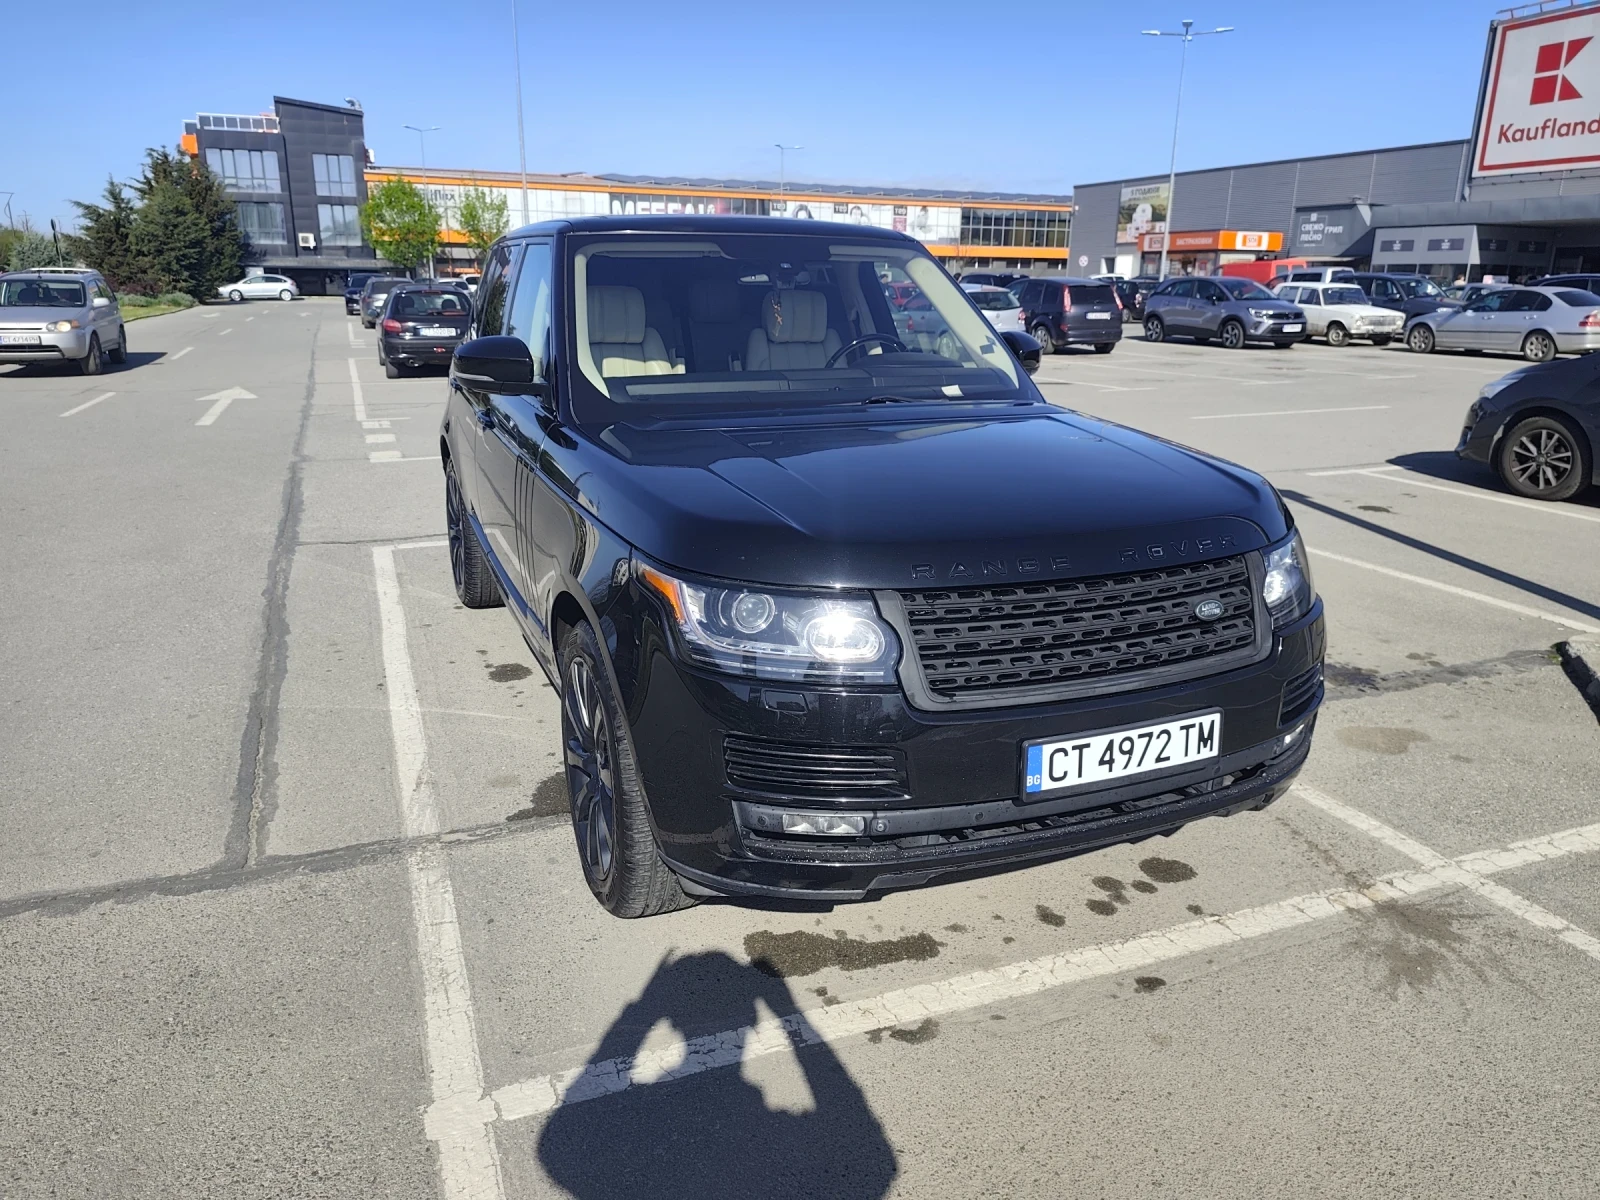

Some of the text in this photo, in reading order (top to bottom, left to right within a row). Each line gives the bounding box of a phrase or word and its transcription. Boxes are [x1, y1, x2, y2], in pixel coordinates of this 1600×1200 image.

[1498, 114, 1600, 144] Kaufland
[1324, 226, 1343, 234] ГРИЛ
[1300, 233, 1322, 241] ЛЕСНО
[911, 533, 1239, 580] RANGE ROVER
[1202, 603, 1216, 611] LAND
[1204, 608, 1220, 616] ROVER
[1048, 719, 1215, 783] CT 4972 TM
[1026, 775, 1041, 786] BG
